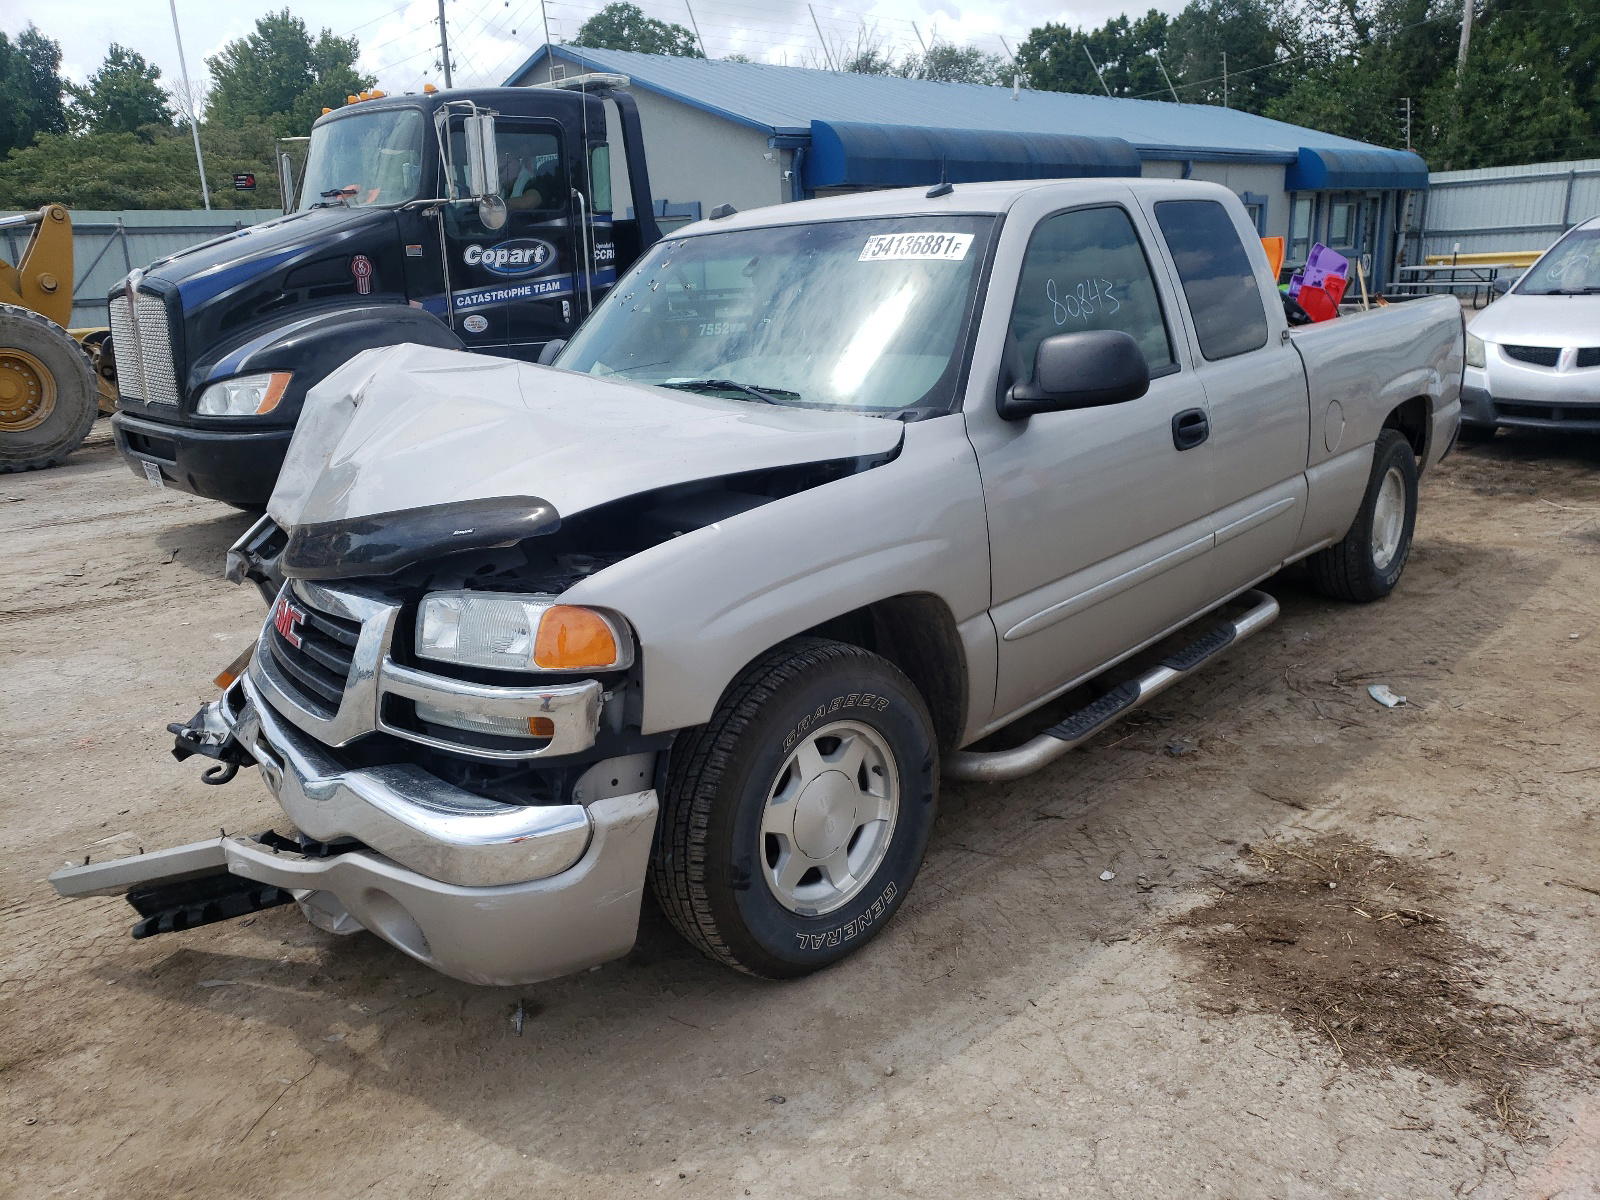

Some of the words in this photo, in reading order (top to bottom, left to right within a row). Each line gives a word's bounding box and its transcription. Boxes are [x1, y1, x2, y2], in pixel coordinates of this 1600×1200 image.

[463, 244, 546, 269] Copart
[456, 284, 531, 307] CATASTROPHE
[535, 281, 560, 294] TEAM
[782, 693, 890, 753] GRABBER
[796, 881, 898, 949] GENERAL
